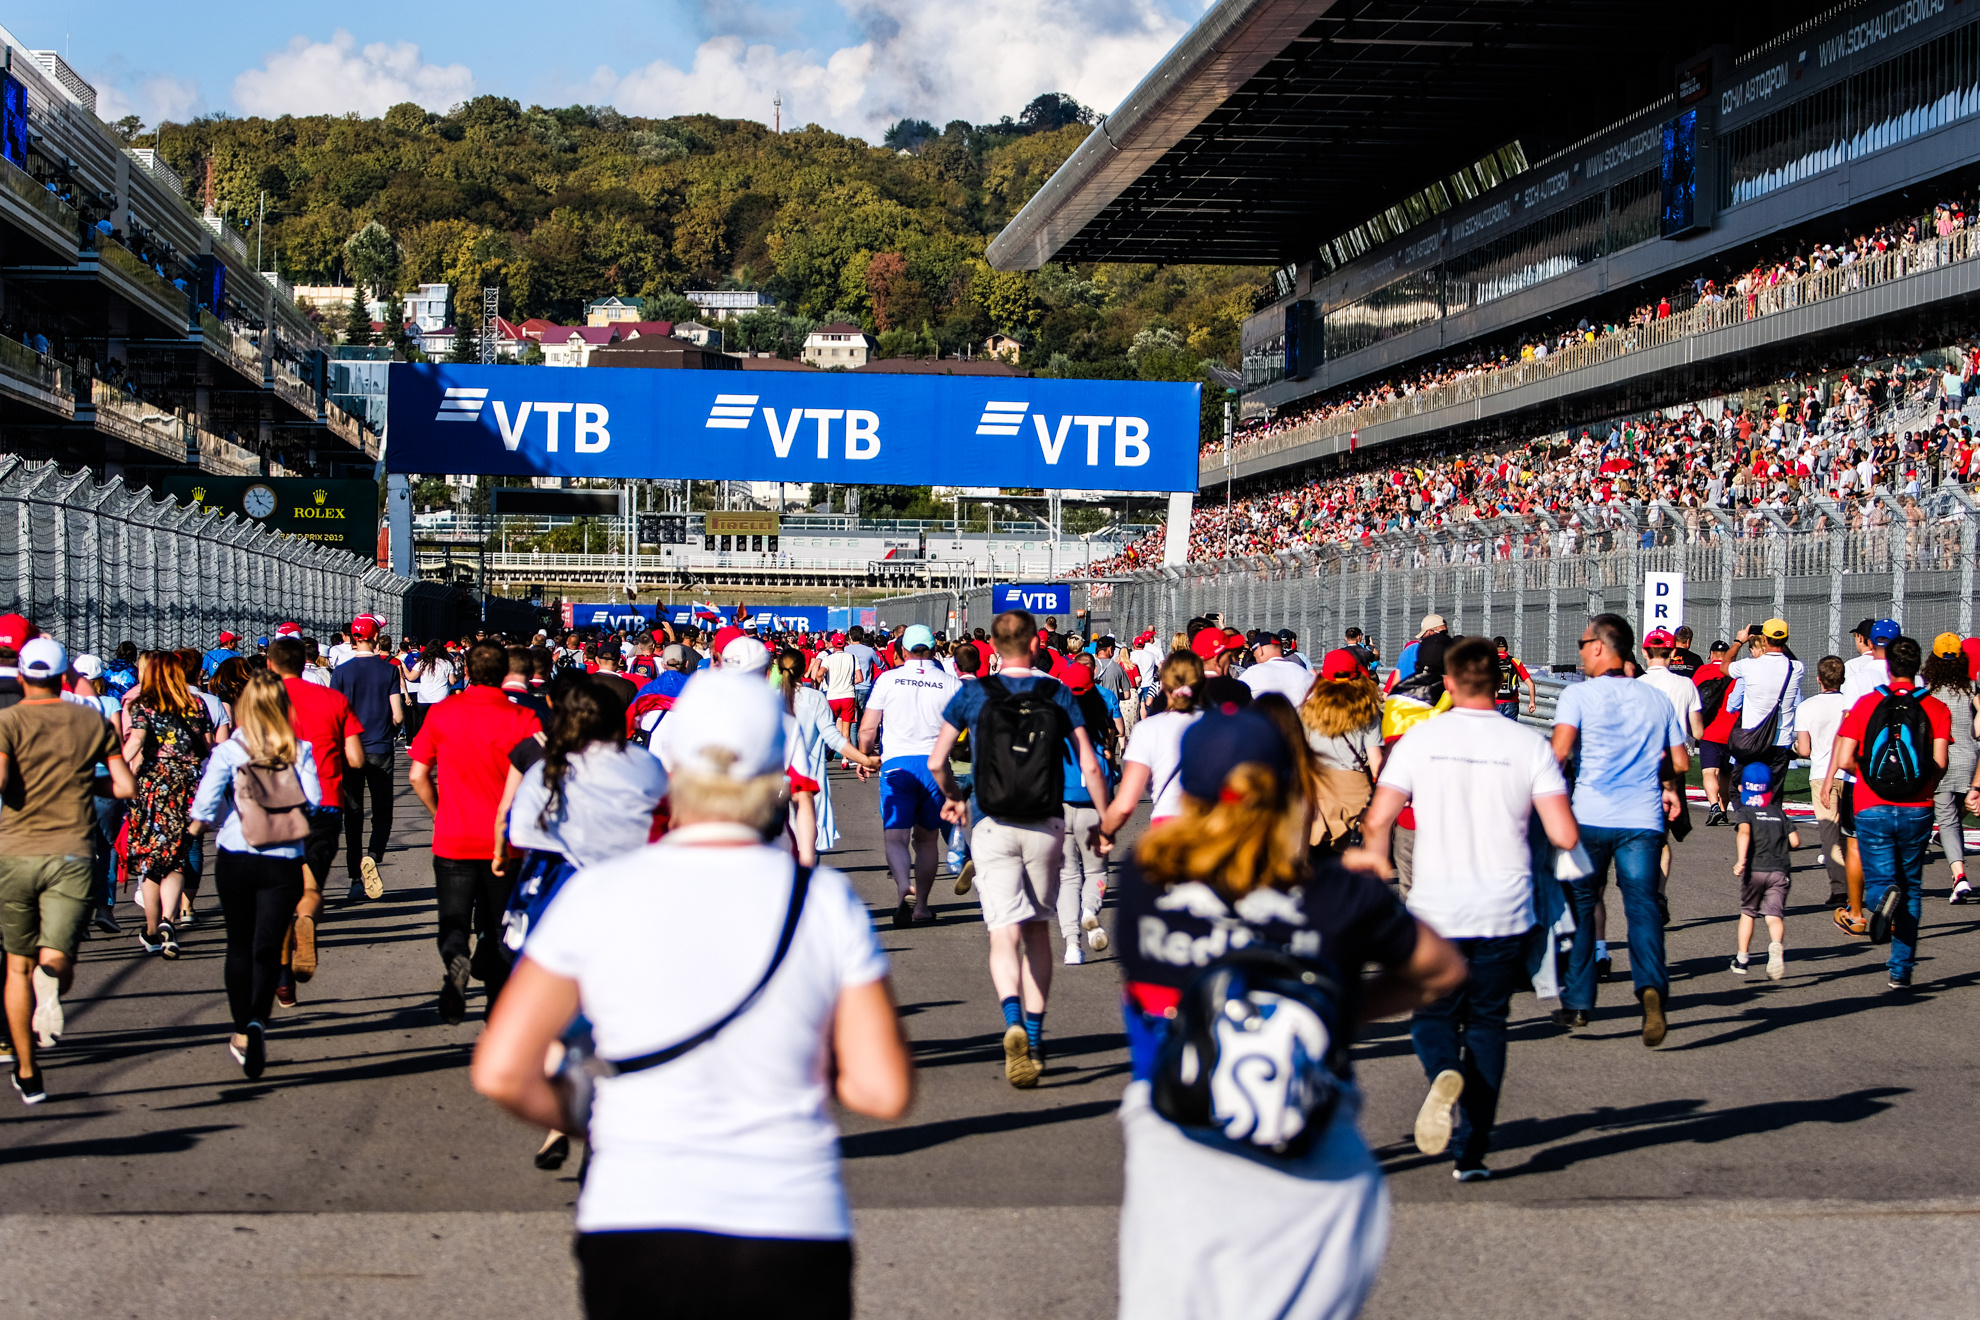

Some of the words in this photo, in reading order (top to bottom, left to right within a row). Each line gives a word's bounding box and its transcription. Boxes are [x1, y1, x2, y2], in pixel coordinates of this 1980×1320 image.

[1721, 84, 1743, 115] СОЧИ
[1744, 61, 1789, 104] АВТОДРОМ
[1585, 123, 1663, 179] WWW.SOCHIAUTODROM.R
[492, 401, 610, 453] VTB
[763, 408, 880, 459] VTB
[1033, 415, 1150, 466] VTB
[294, 504, 345, 518] ROLEX
[711, 517, 773, 530] PIRELLI
[304, 533, 323, 541] PRIX
[324, 533, 344, 542] 2019
[1022, 593, 1058, 609] VTB
[608, 615, 646, 632] VTB
[773, 616, 809, 633] VTB
[894, 678, 943, 690] PETRONAS
[1745, 781, 1767, 792] SOCHI
[1138, 914, 1228, 967] Red
